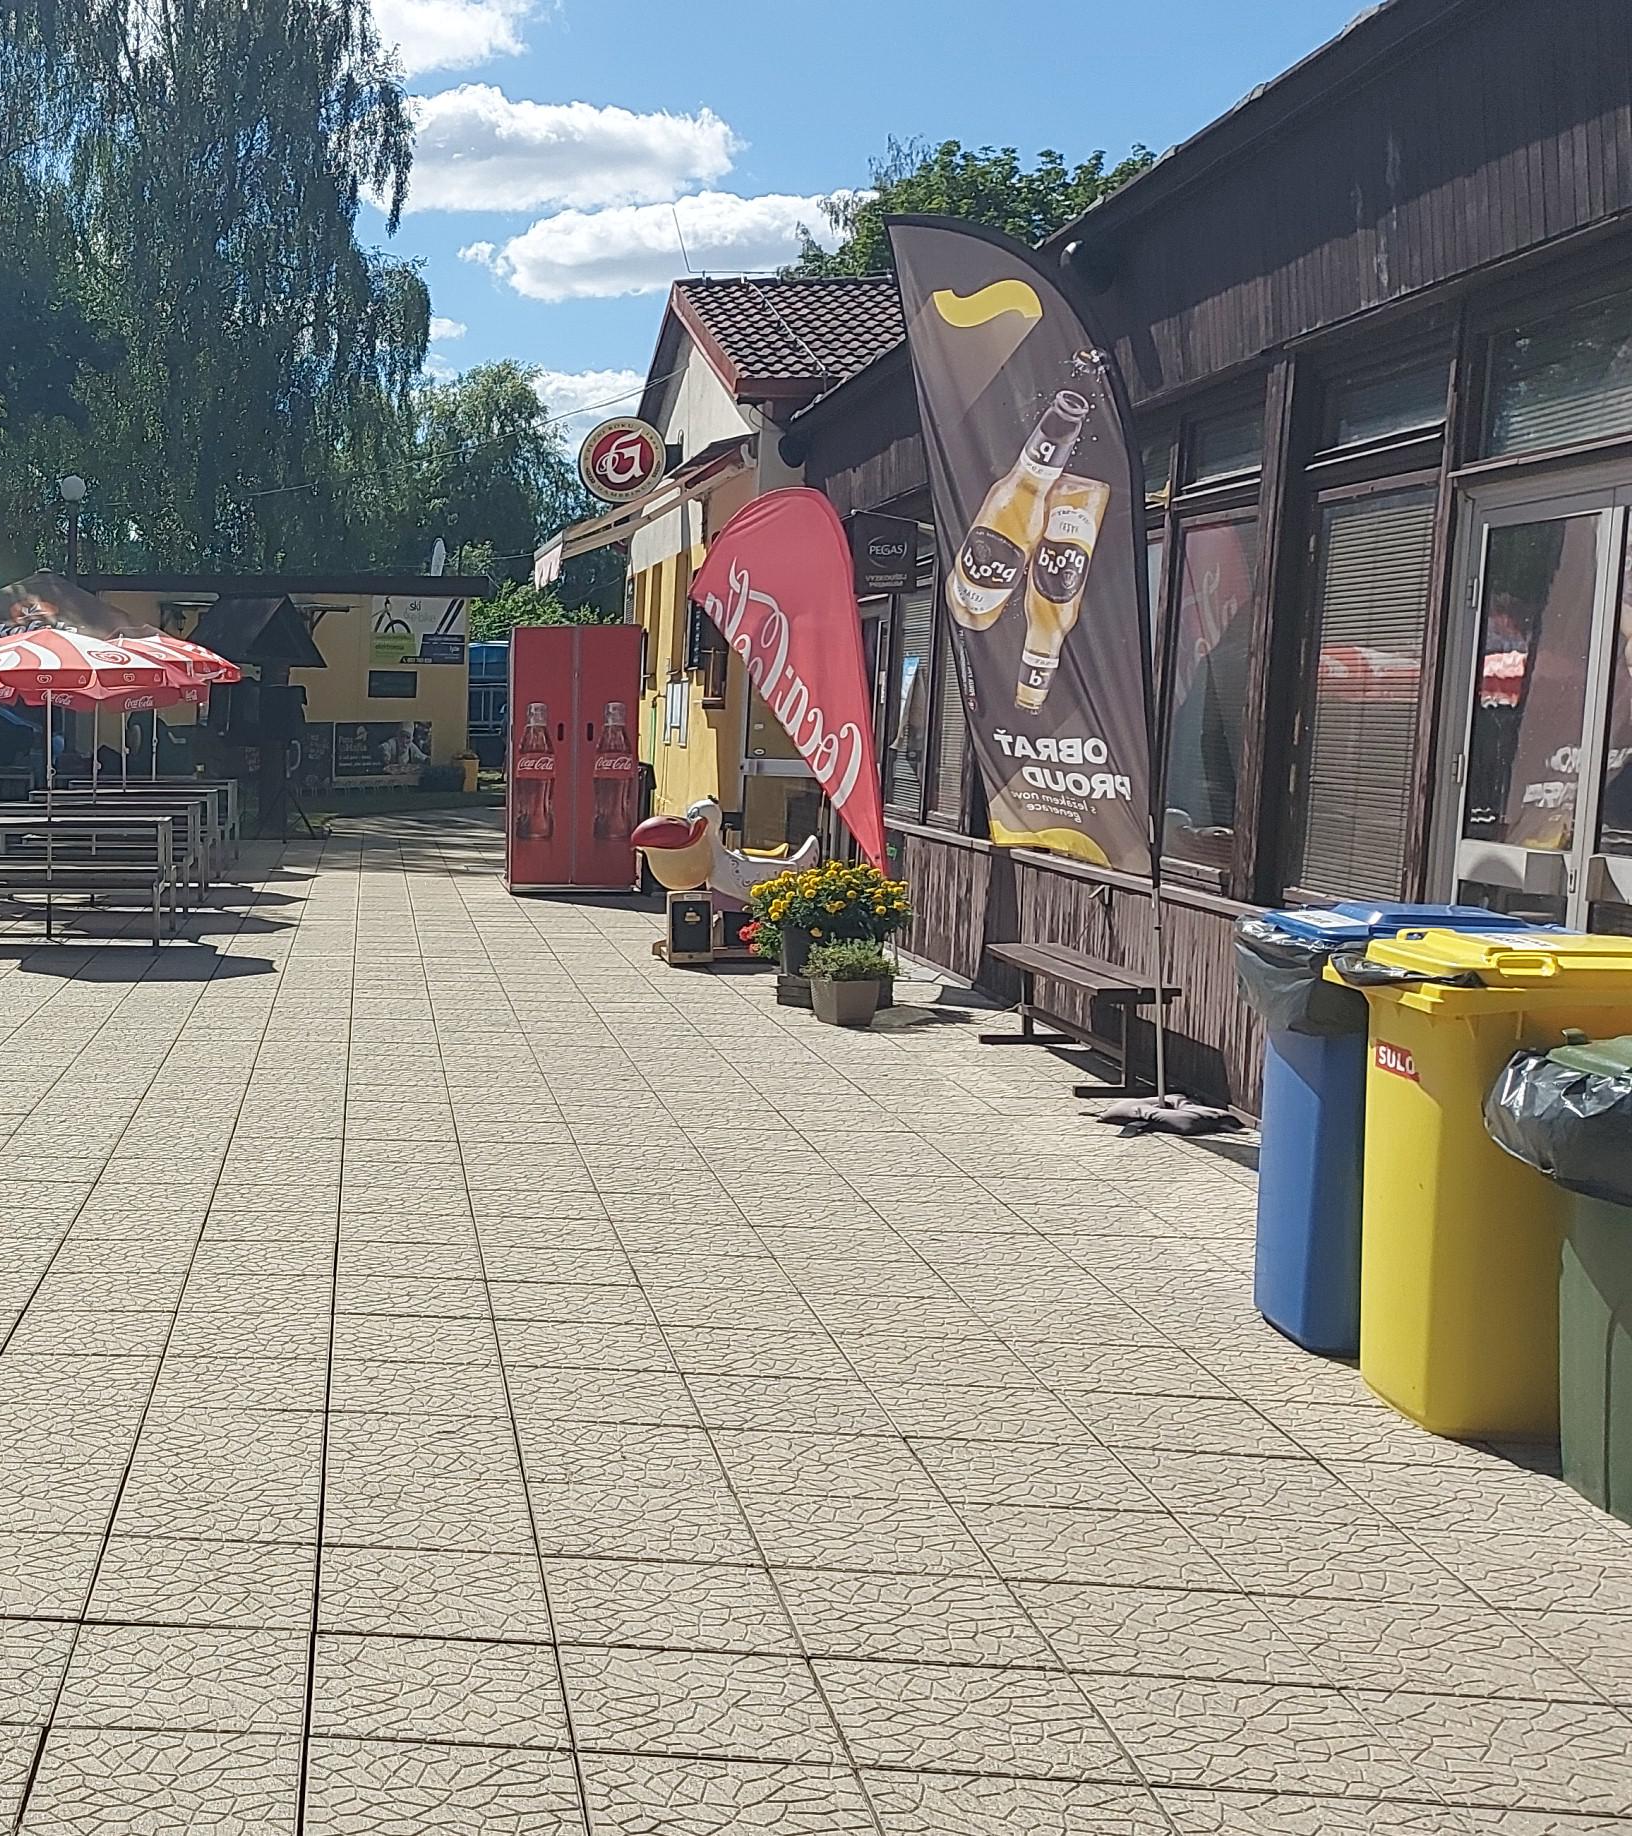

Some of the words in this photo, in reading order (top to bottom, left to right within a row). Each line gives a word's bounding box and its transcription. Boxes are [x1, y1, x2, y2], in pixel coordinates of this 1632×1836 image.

[869, 544, 903, 556] PEGAS
[409, 600, 422, 611] ski
[517, 756, 554, 770] Coca-Cola
[594, 756, 632, 770] Coca-Cola
[1378, 1045, 1416, 1075] SULO
